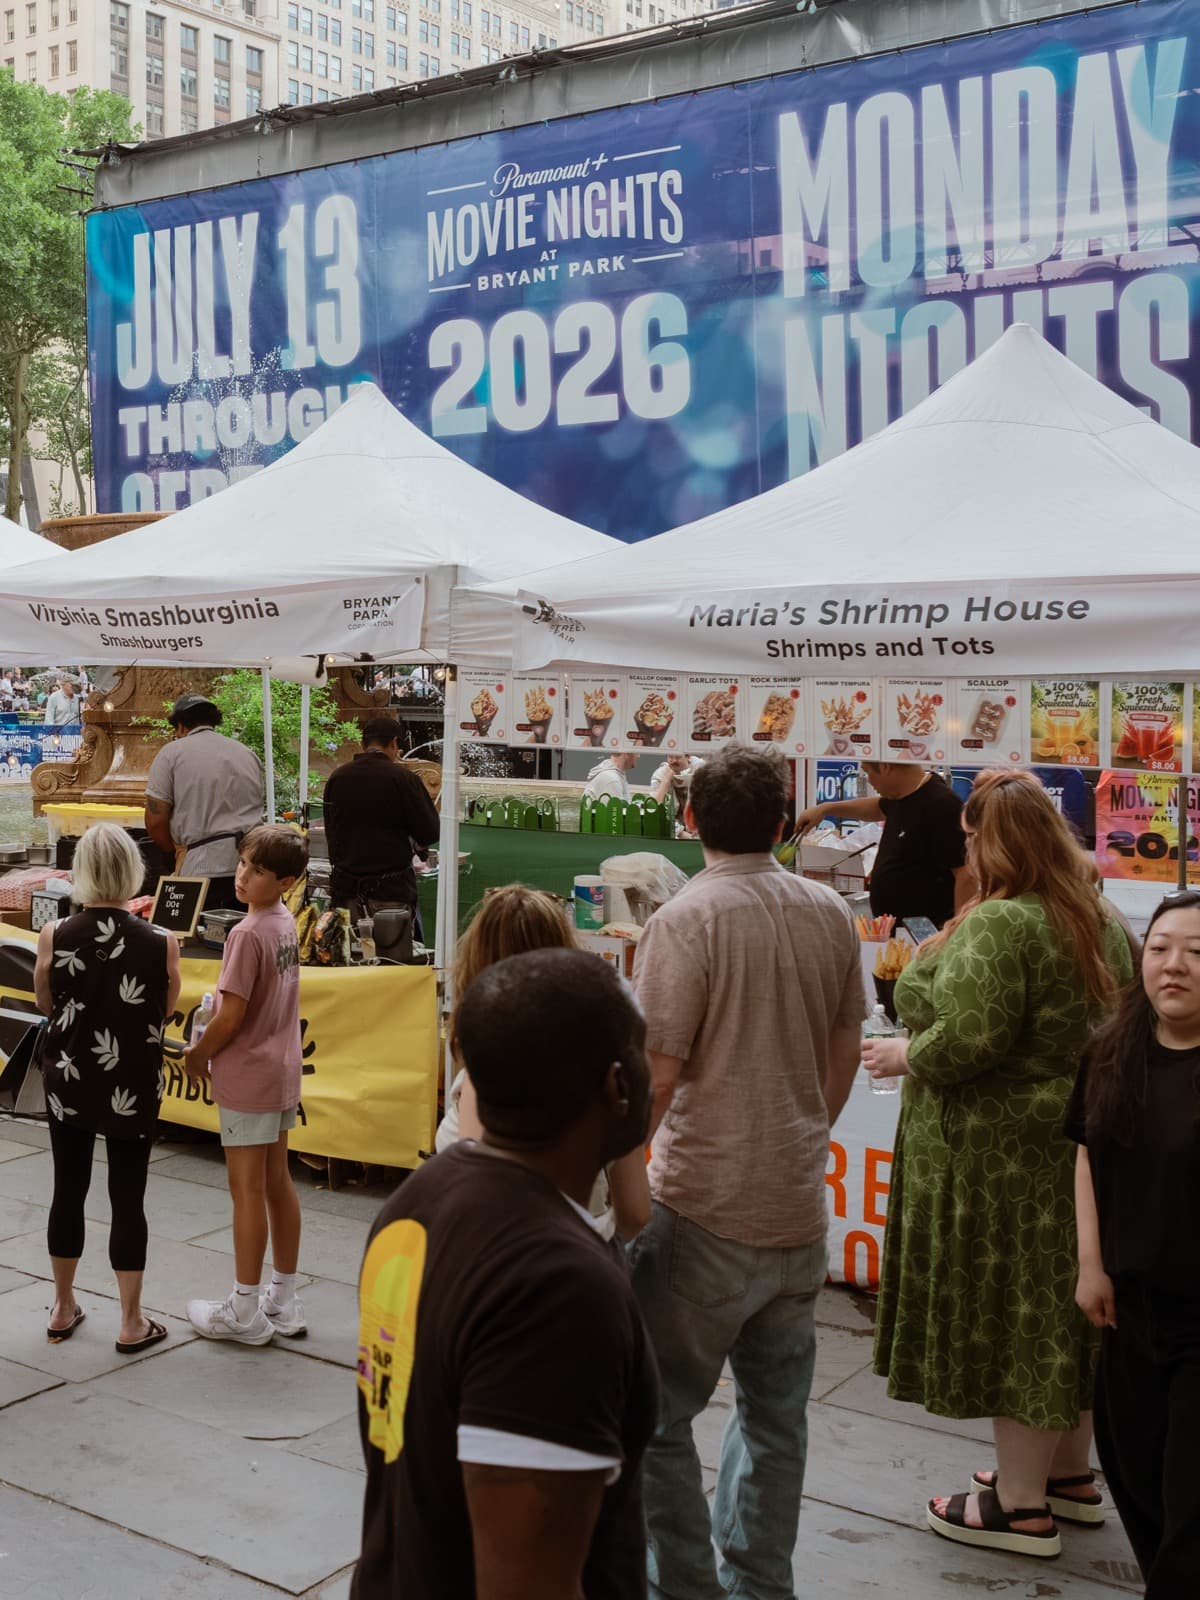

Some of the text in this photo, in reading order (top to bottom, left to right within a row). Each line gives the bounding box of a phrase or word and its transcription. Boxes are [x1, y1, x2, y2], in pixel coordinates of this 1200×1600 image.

[779, 37, 1187, 298] MONDAY
[427, 169, 683, 282] MOVIE NIGHTS
[540, 249, 557, 262] AT
[477, 255, 625, 291] BRYANT PARK
[116, 194, 361, 390] JULY 13
[430, 293, 690, 436] 2026
[343, 596, 400, 609] BRYANT
[28, 598, 280, 627] Virginia Smashburginia
[689, 597, 1090, 629] Maria's Shrimp House
[100, 633, 203, 651] Smashburgers
[766, 637, 995, 660] Shrimps and Tots
[967, 679, 1009, 687] SCALLOP
[1053, 682, 1084, 691] 100%
[1054, 691, 1079, 701] Fresh
[1135, 686, 1169, 695] 100%
[1037, 698, 1096, 709] Squeezed Juice
[1136, 695, 1163, 705] Fresh
[1118, 702, 1181, 714] Squeezed Juice
[1152, 761, 1175, 770] $8.00
